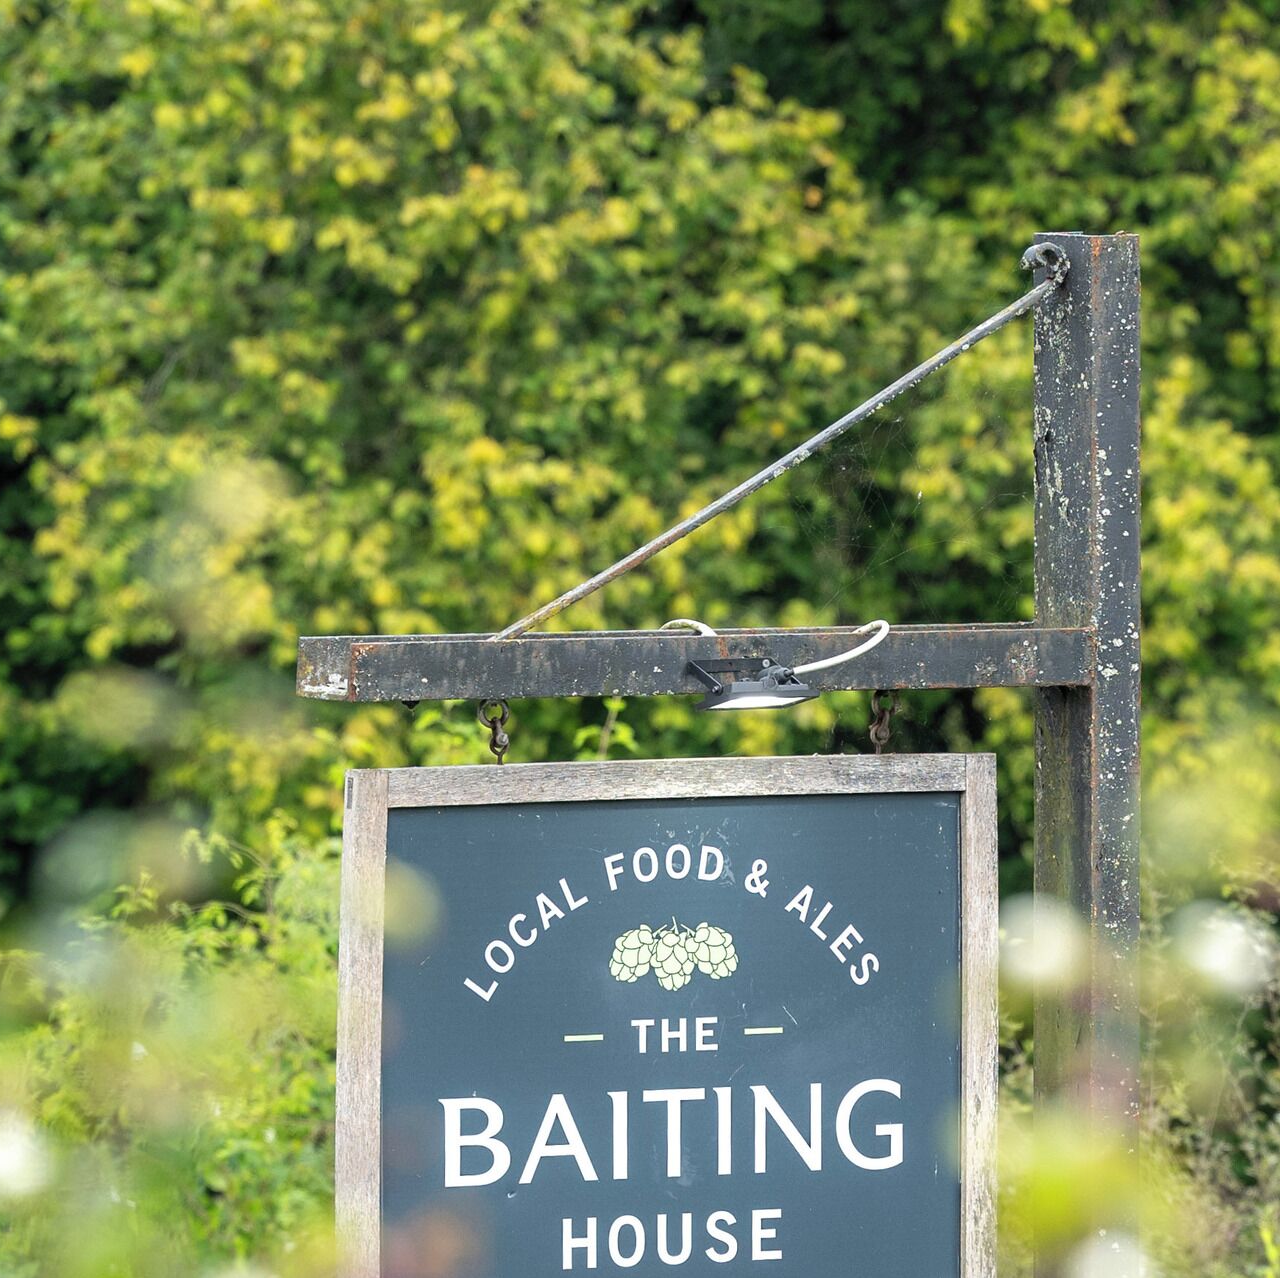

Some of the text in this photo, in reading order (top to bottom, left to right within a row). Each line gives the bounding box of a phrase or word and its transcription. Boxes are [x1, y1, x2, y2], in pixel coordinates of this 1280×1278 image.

[463, 844, 880, 1001] LOCAL FOOD & ALES
[631, 1016, 718, 1053] THE
[438, 1079, 904, 1188] BAITING
[561, 1208, 782, 1270] HOUSE
